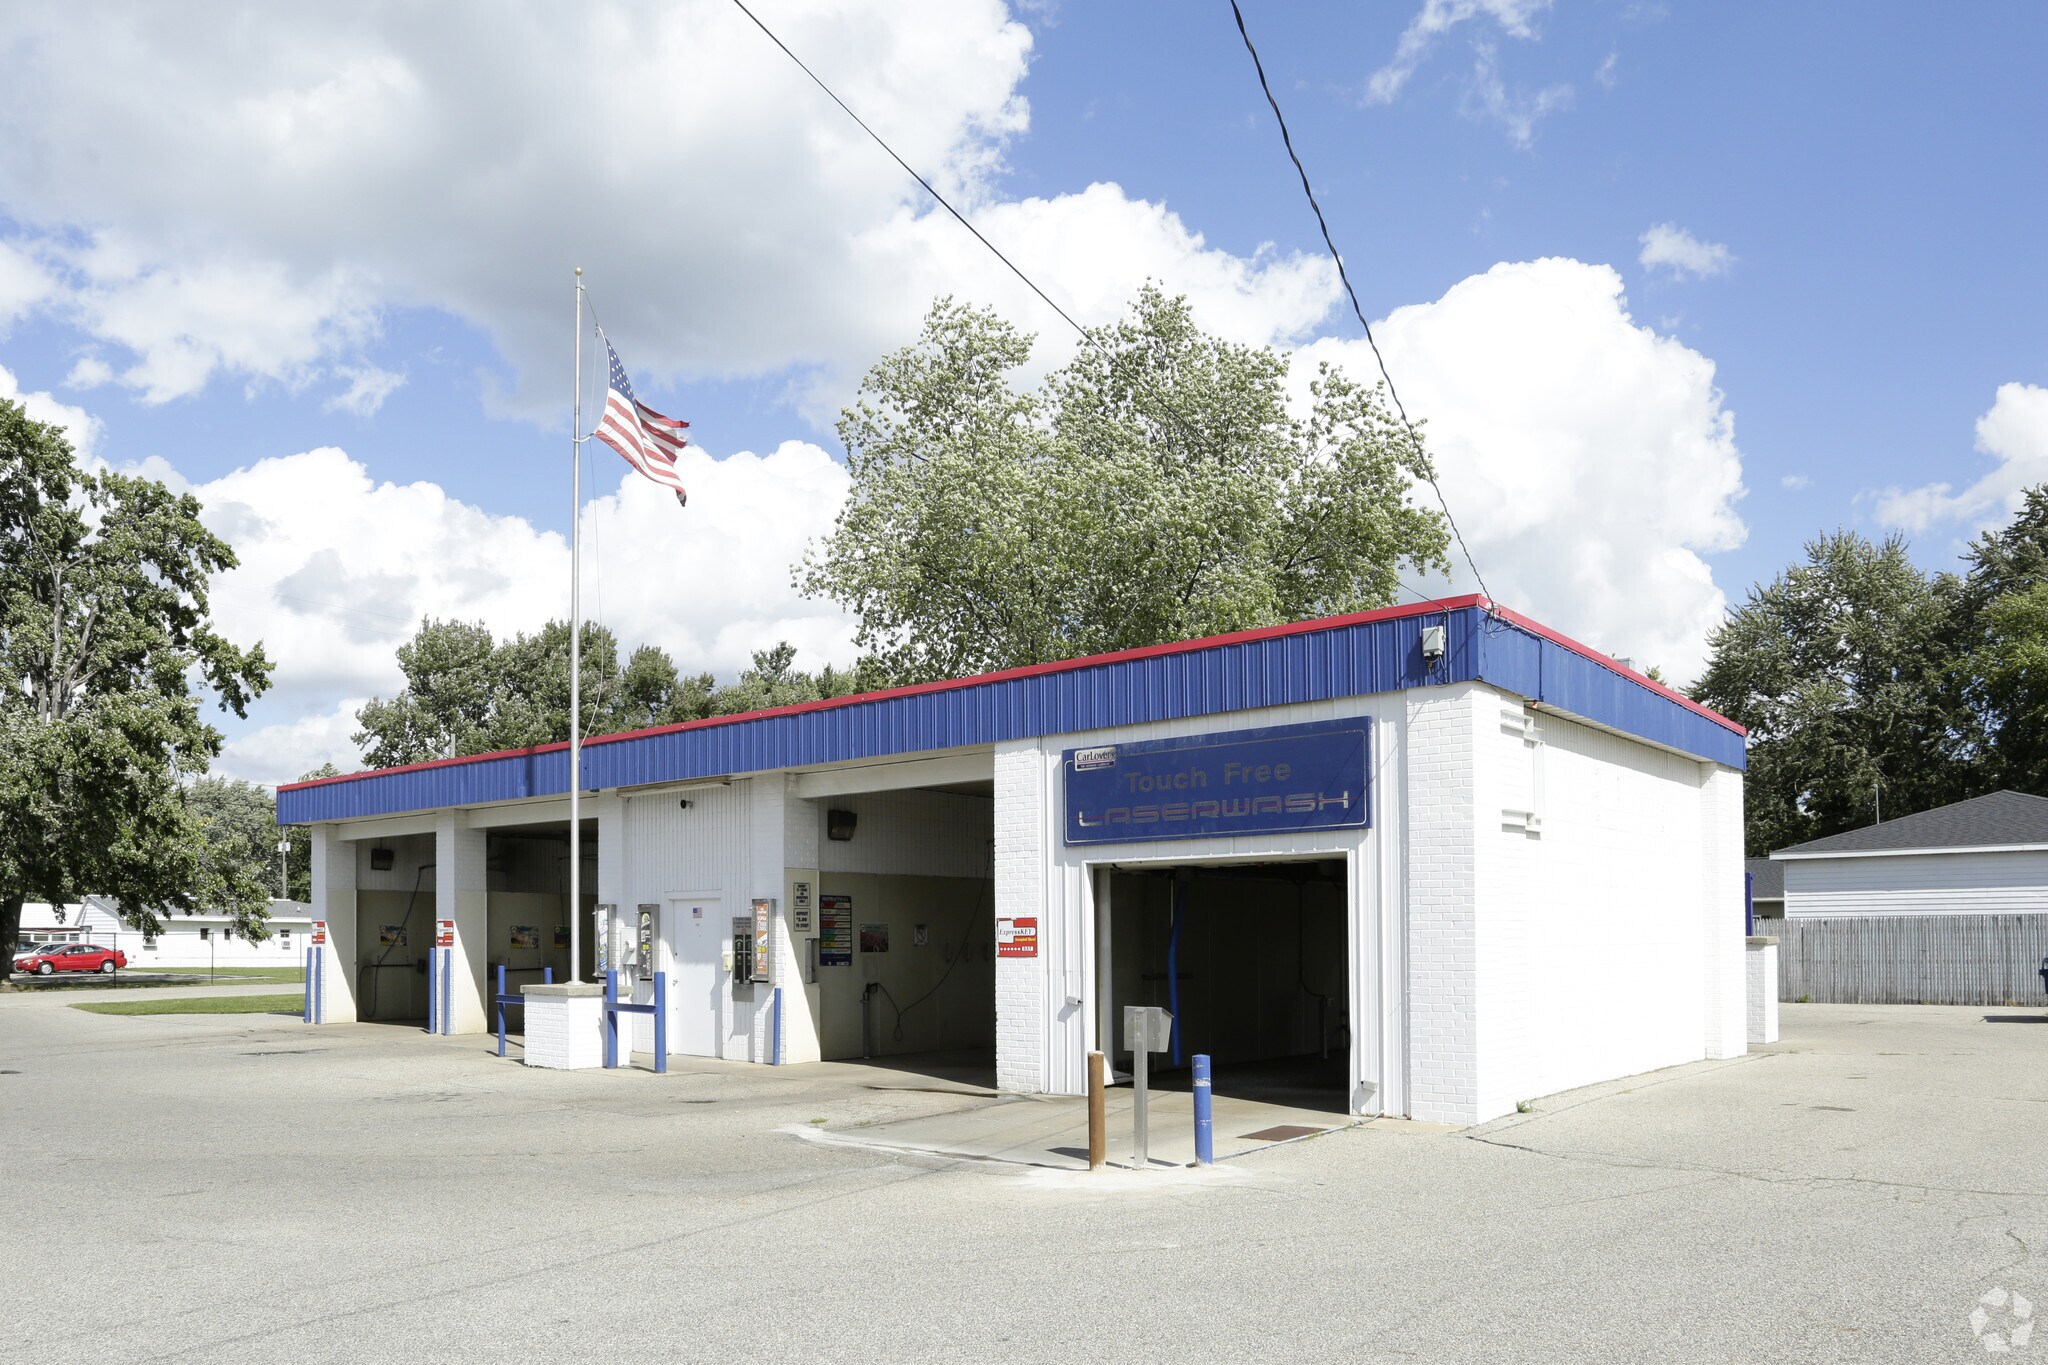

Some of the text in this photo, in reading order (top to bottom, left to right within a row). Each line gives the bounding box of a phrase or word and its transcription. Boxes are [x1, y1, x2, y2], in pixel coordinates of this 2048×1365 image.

[1076, 751, 1115, 761] CarLovers
[1125, 762, 1292, 793] Touch Free
[1078, 791, 1349, 827] LASERWASH
